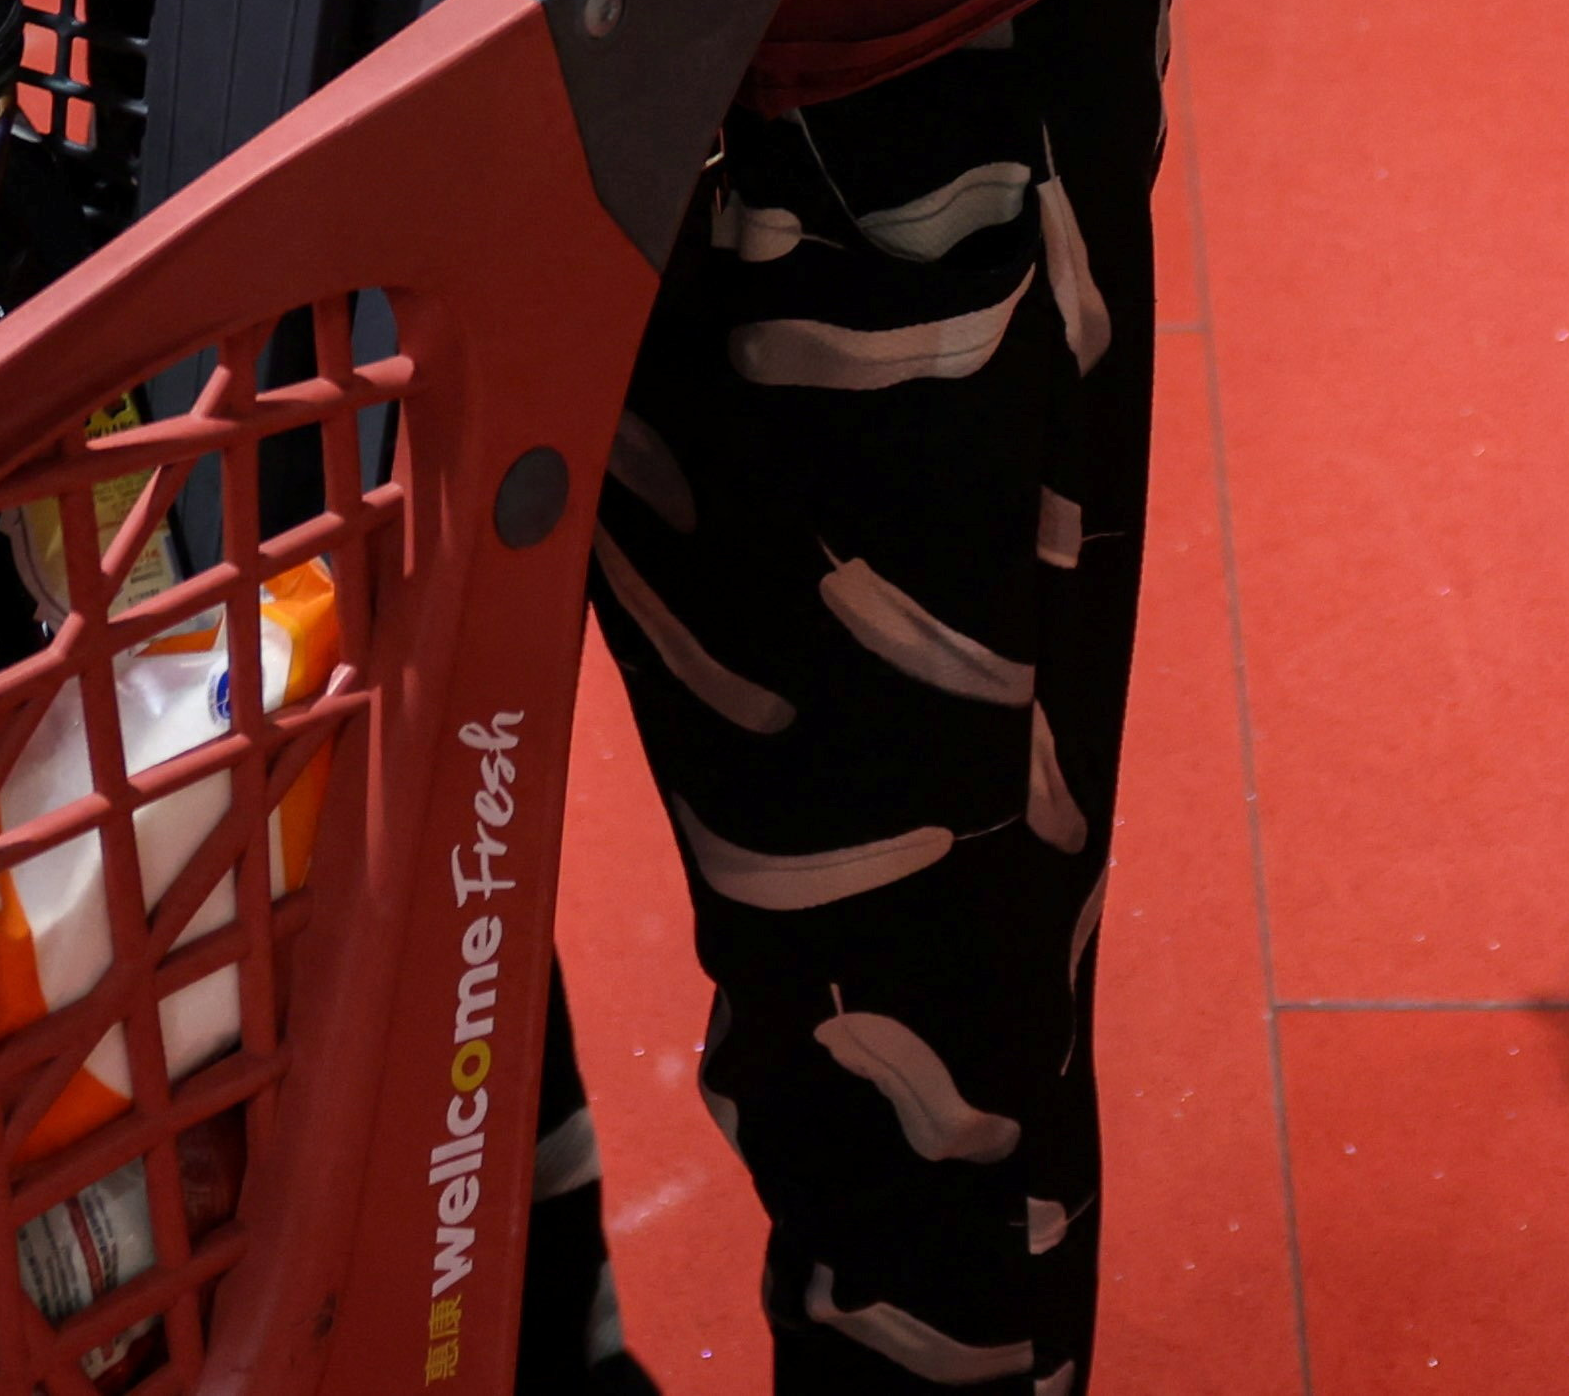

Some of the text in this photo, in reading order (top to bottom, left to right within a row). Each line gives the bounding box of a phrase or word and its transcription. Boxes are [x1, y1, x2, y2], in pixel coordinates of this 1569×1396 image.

[427, 707, 527, 1299] wellcome Fresh
[423, 1295, 462, 1388] 惠康
